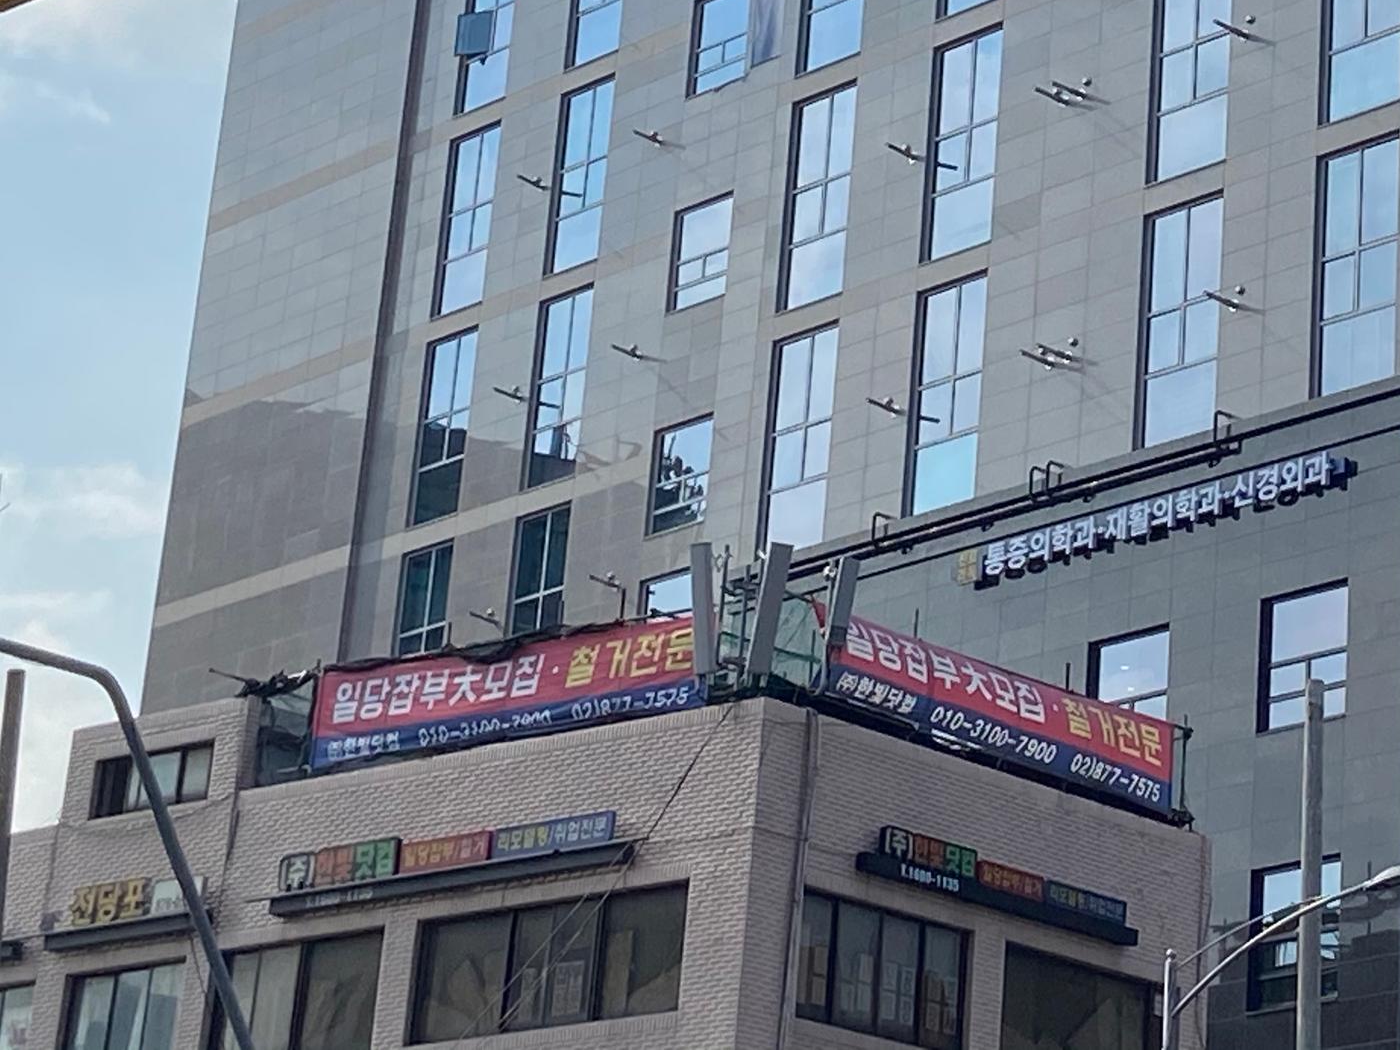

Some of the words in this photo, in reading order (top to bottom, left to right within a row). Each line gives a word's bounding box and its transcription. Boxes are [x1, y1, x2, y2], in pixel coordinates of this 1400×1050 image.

[564, 626, 695, 689] 철거전문
[930, 705, 1058, 765] 010-3100-7900
[1069, 752, 1161, 803] 02)877-7575
[1062, 697, 1164, 768] 철거전문
[71, 878, 147, 926] 전당포
